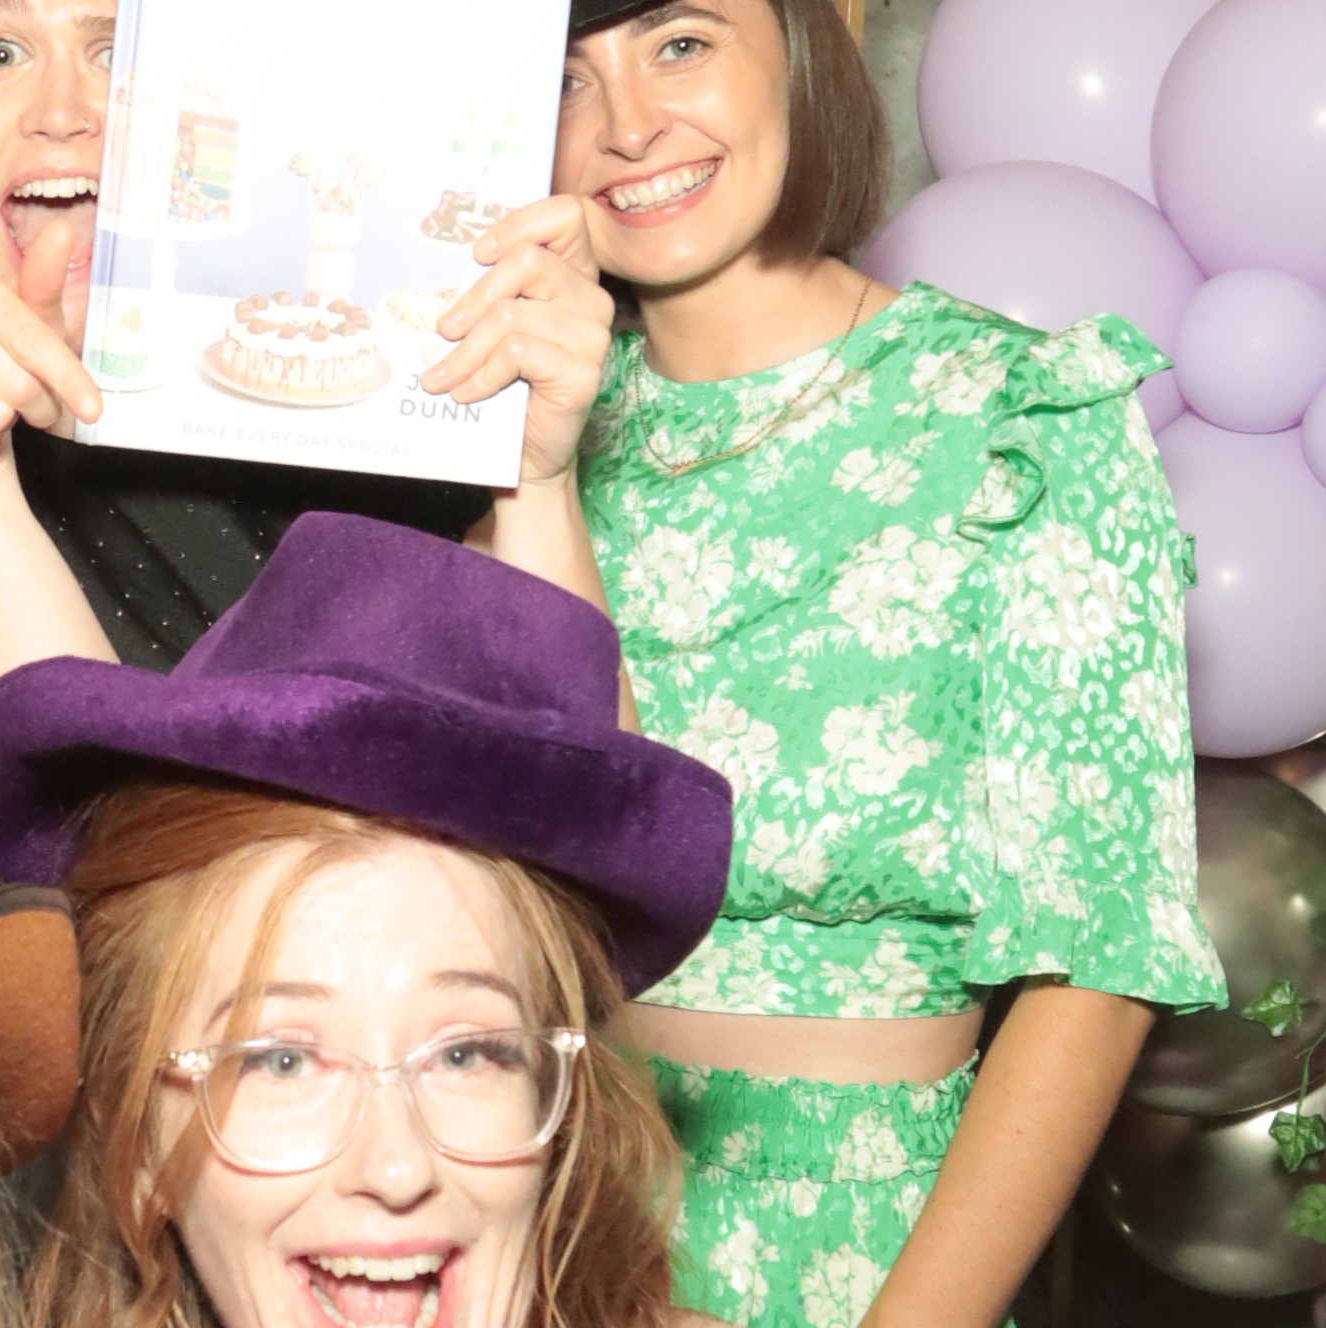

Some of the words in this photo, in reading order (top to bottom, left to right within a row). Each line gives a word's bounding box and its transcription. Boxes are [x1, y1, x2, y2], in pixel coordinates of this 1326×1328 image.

[399, 398, 482, 423] DUNN
[182, 421, 229, 438] BAKE
[235, 427, 291, 444] EVERY
[297, 433, 332, 449] DAY
[337, 438, 412, 457] SPECIAL
